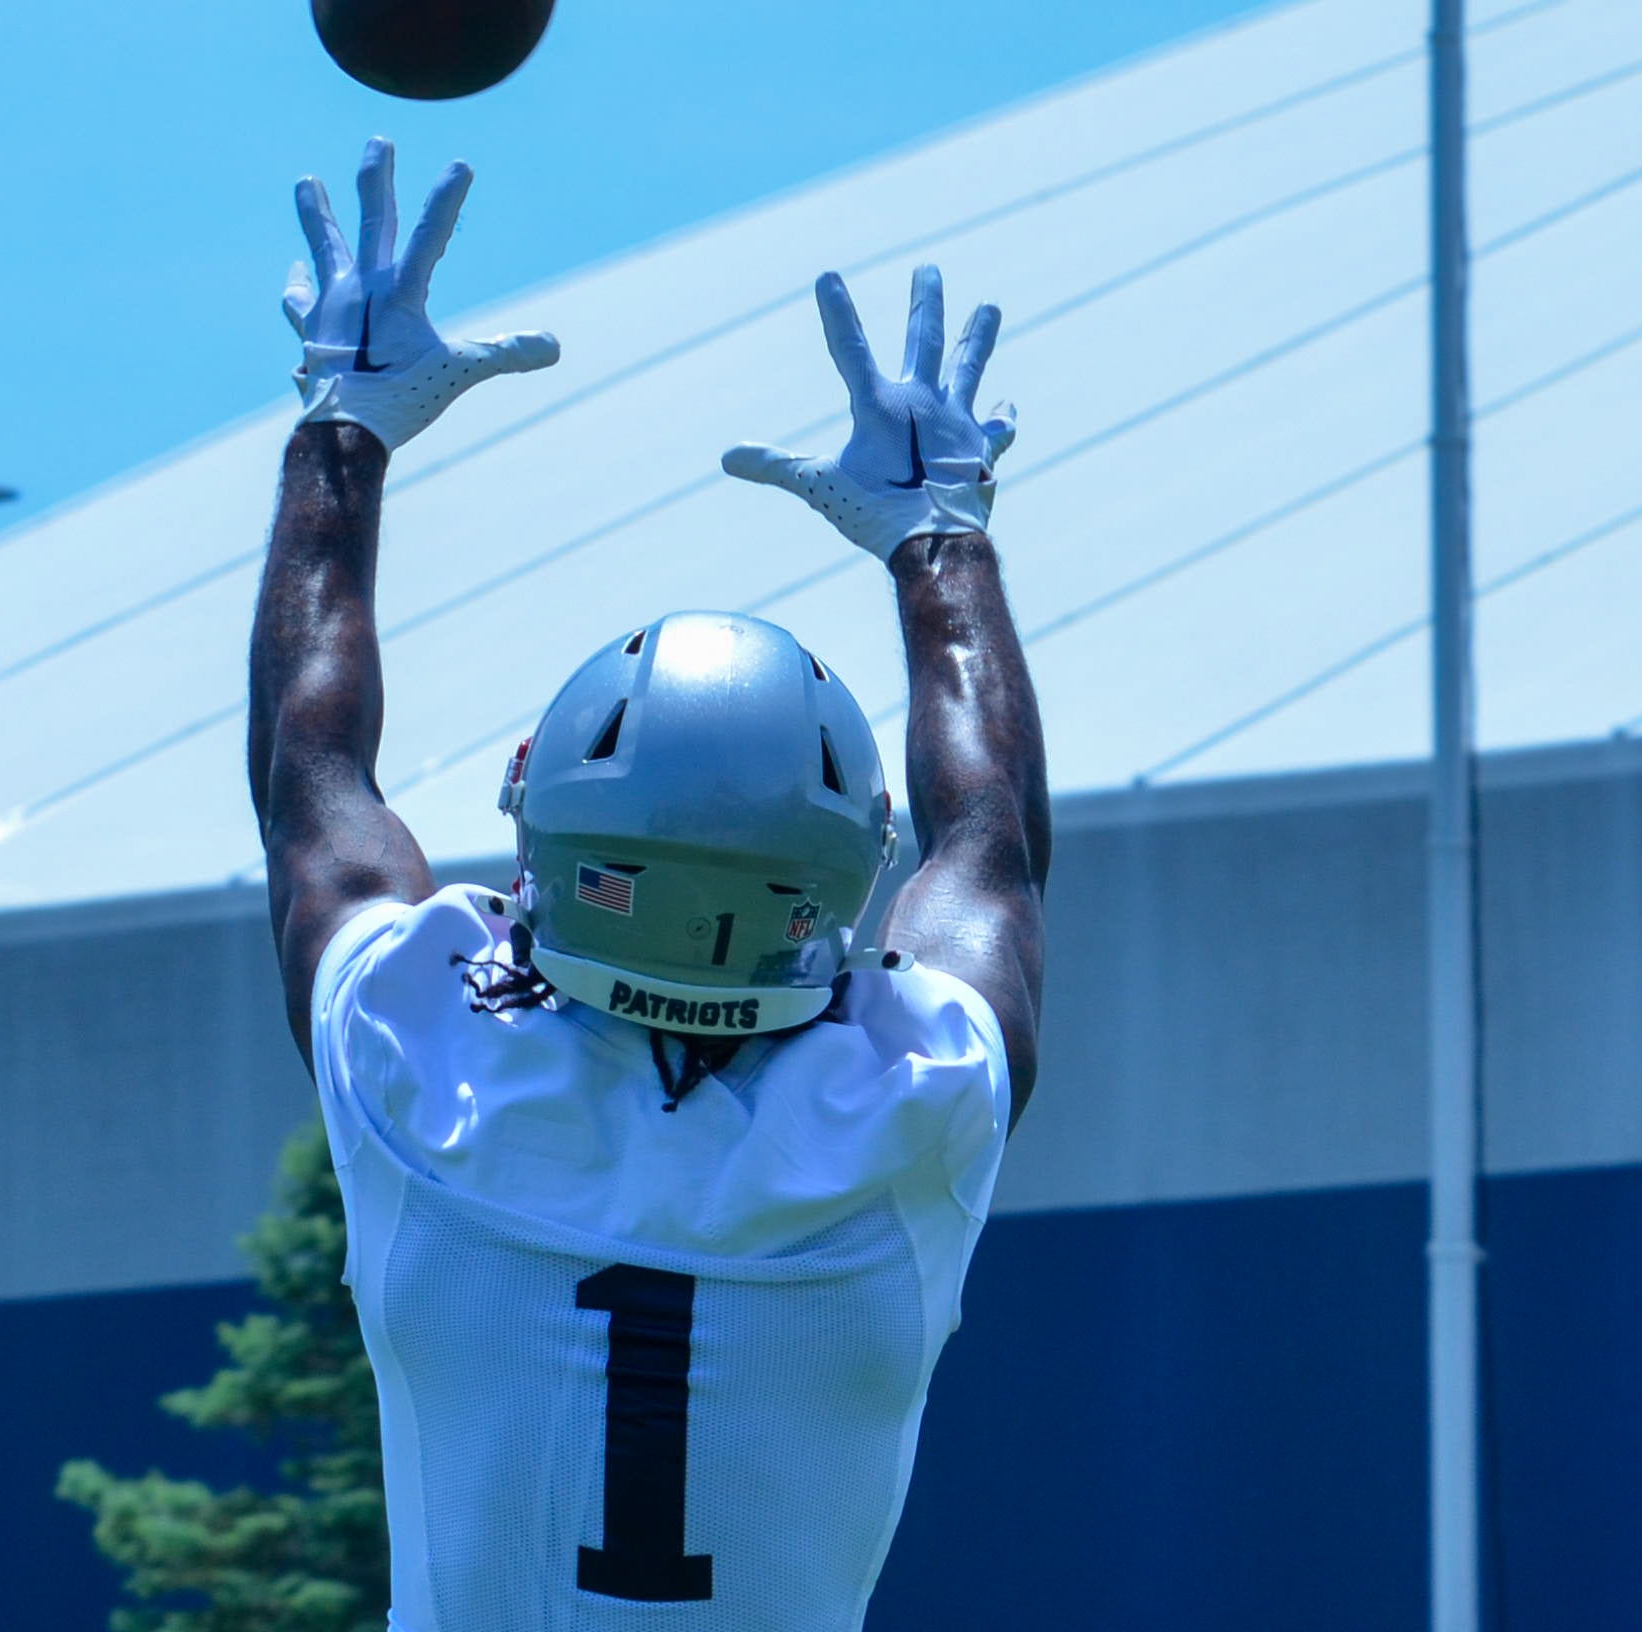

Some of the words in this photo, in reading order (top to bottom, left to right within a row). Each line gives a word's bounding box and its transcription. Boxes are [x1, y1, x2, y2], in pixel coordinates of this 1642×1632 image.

[712, 912, 735, 966] 1
[788, 918, 815, 939] NFL
[609, 980, 759, 1029] PATRIOTS
[575, 1262, 713, 1602] 1
